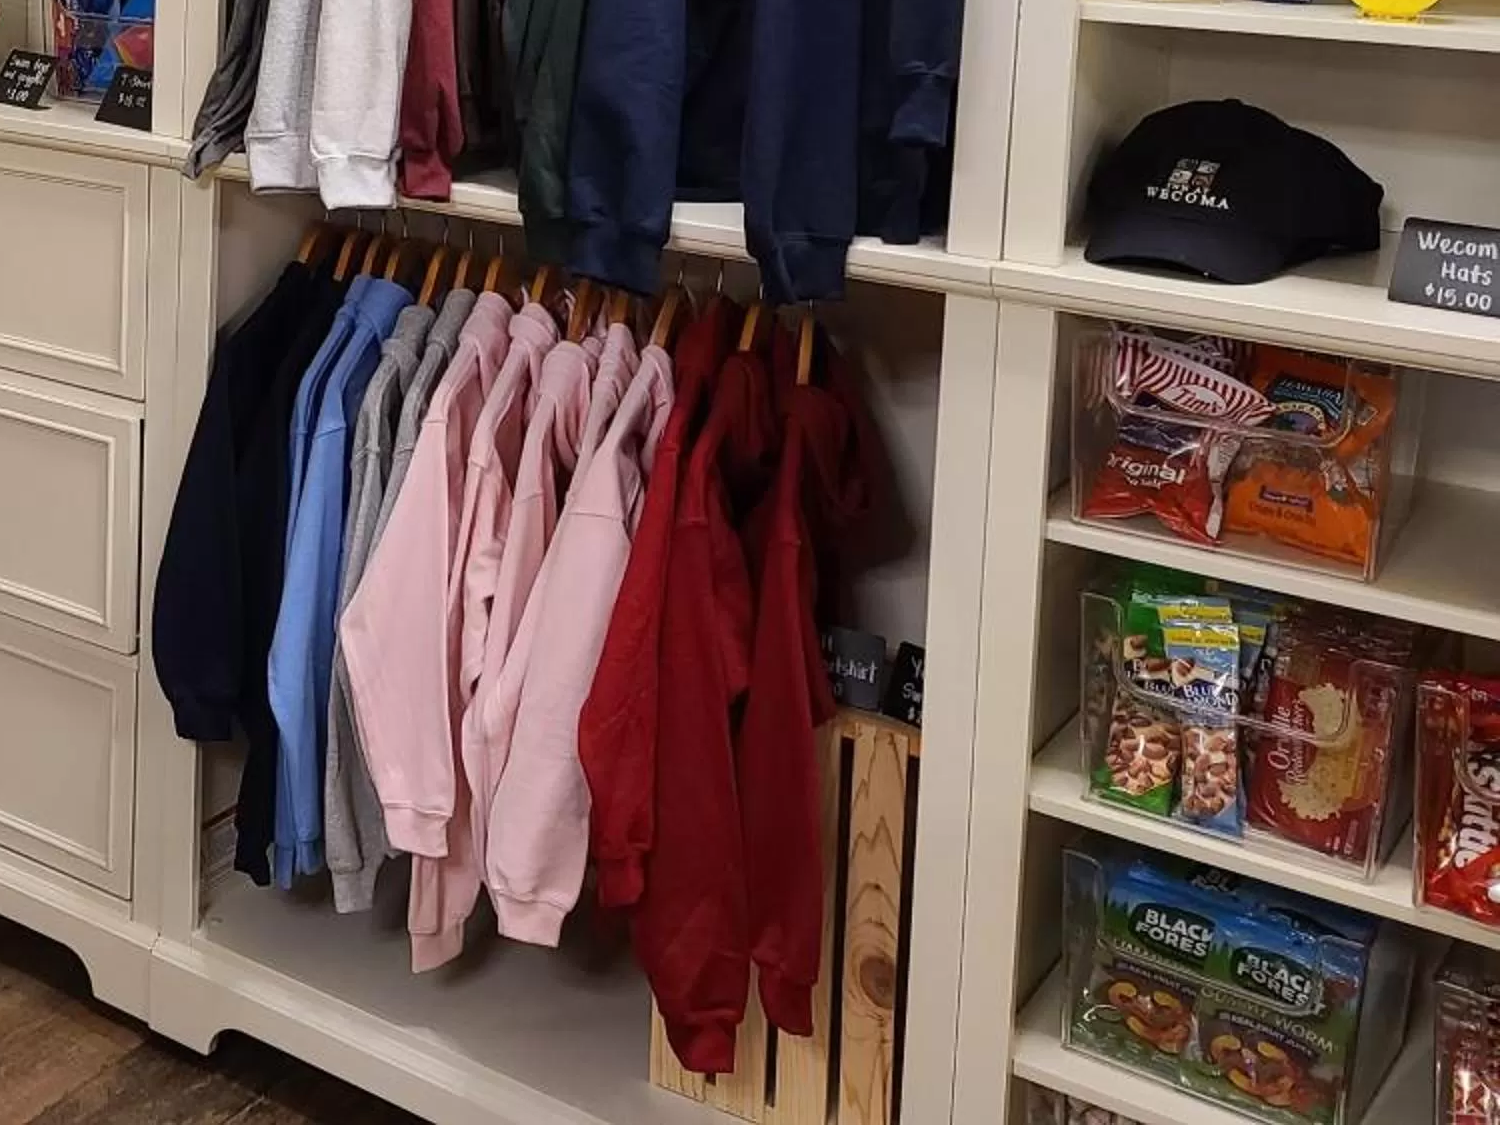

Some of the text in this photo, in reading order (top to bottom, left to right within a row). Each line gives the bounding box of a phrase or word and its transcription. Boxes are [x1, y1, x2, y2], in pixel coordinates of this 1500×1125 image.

[1146, 185, 1230, 210] WECOMA
[1417, 230, 1499, 260] Wecom
[1441, 260, 1493, 287] Hats
[1135, 920, 1208, 958] FORES
[1236, 962, 1310, 1008] FORES
